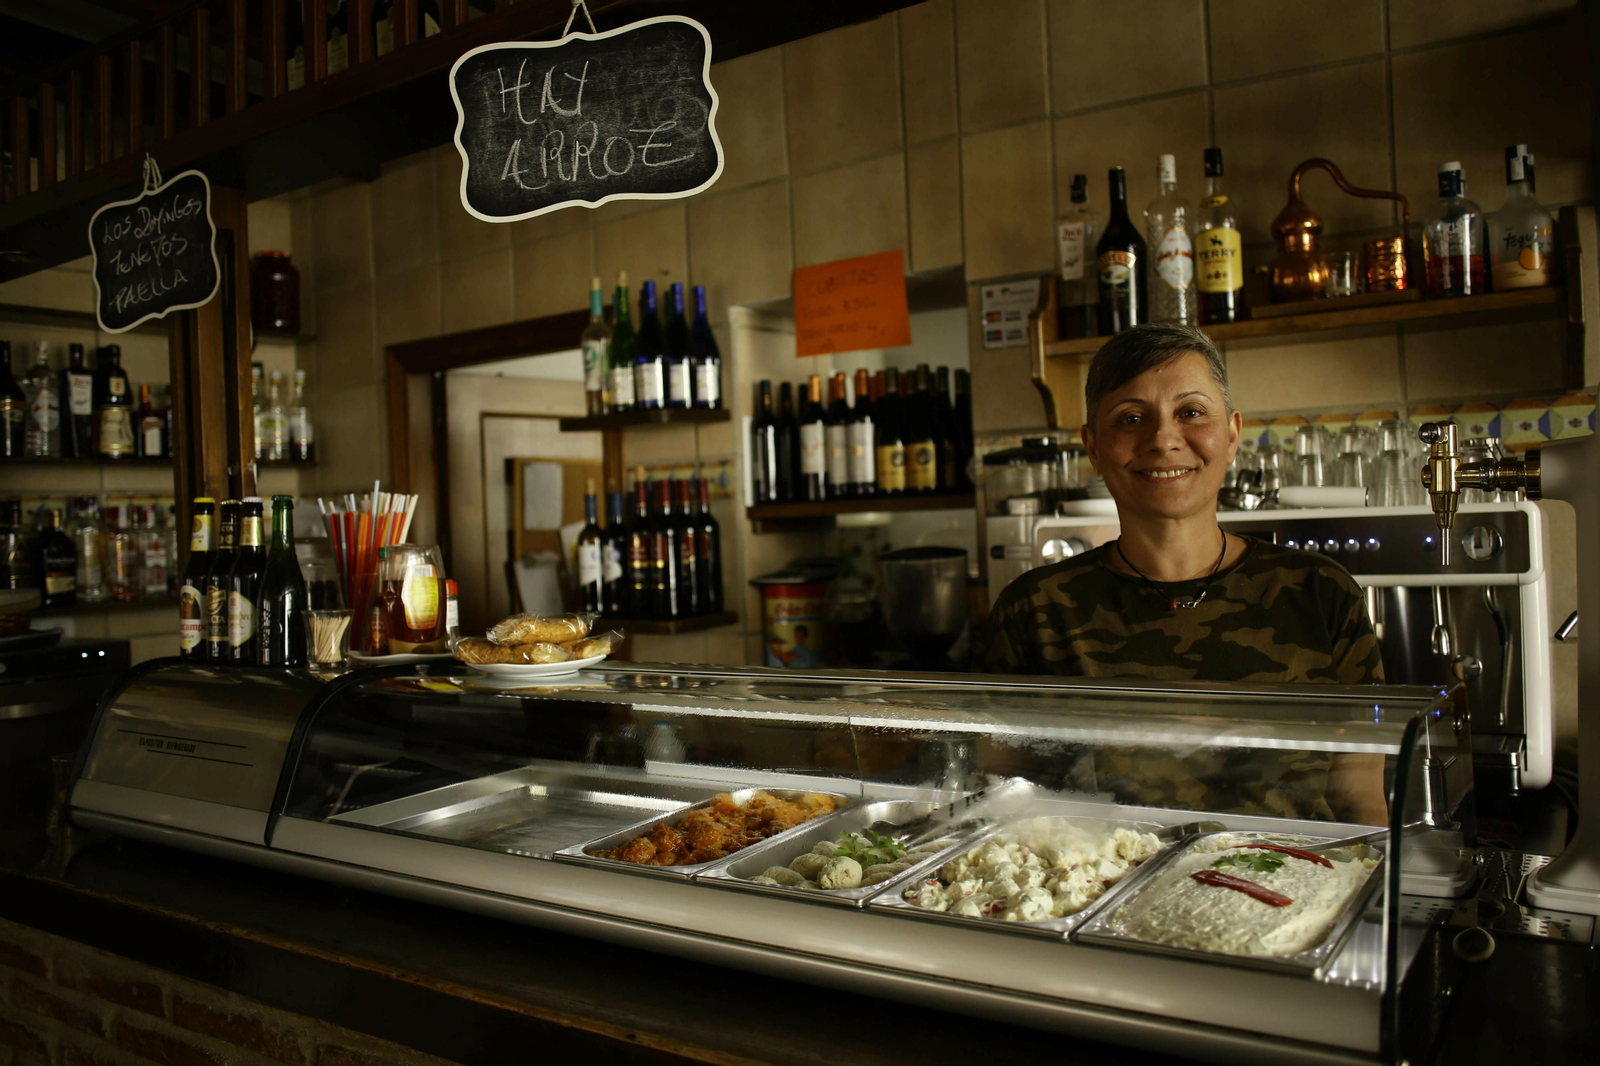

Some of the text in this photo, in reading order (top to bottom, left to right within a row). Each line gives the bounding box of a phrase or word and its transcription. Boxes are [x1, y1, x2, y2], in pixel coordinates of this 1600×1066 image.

[497, 58, 589, 125] HAY
[501, 120, 695, 190] ARROZ
[103, 215, 132, 244] LOS
[1198, 247, 1237, 260] TERRY
[109, 269, 189, 314] PAELLA
